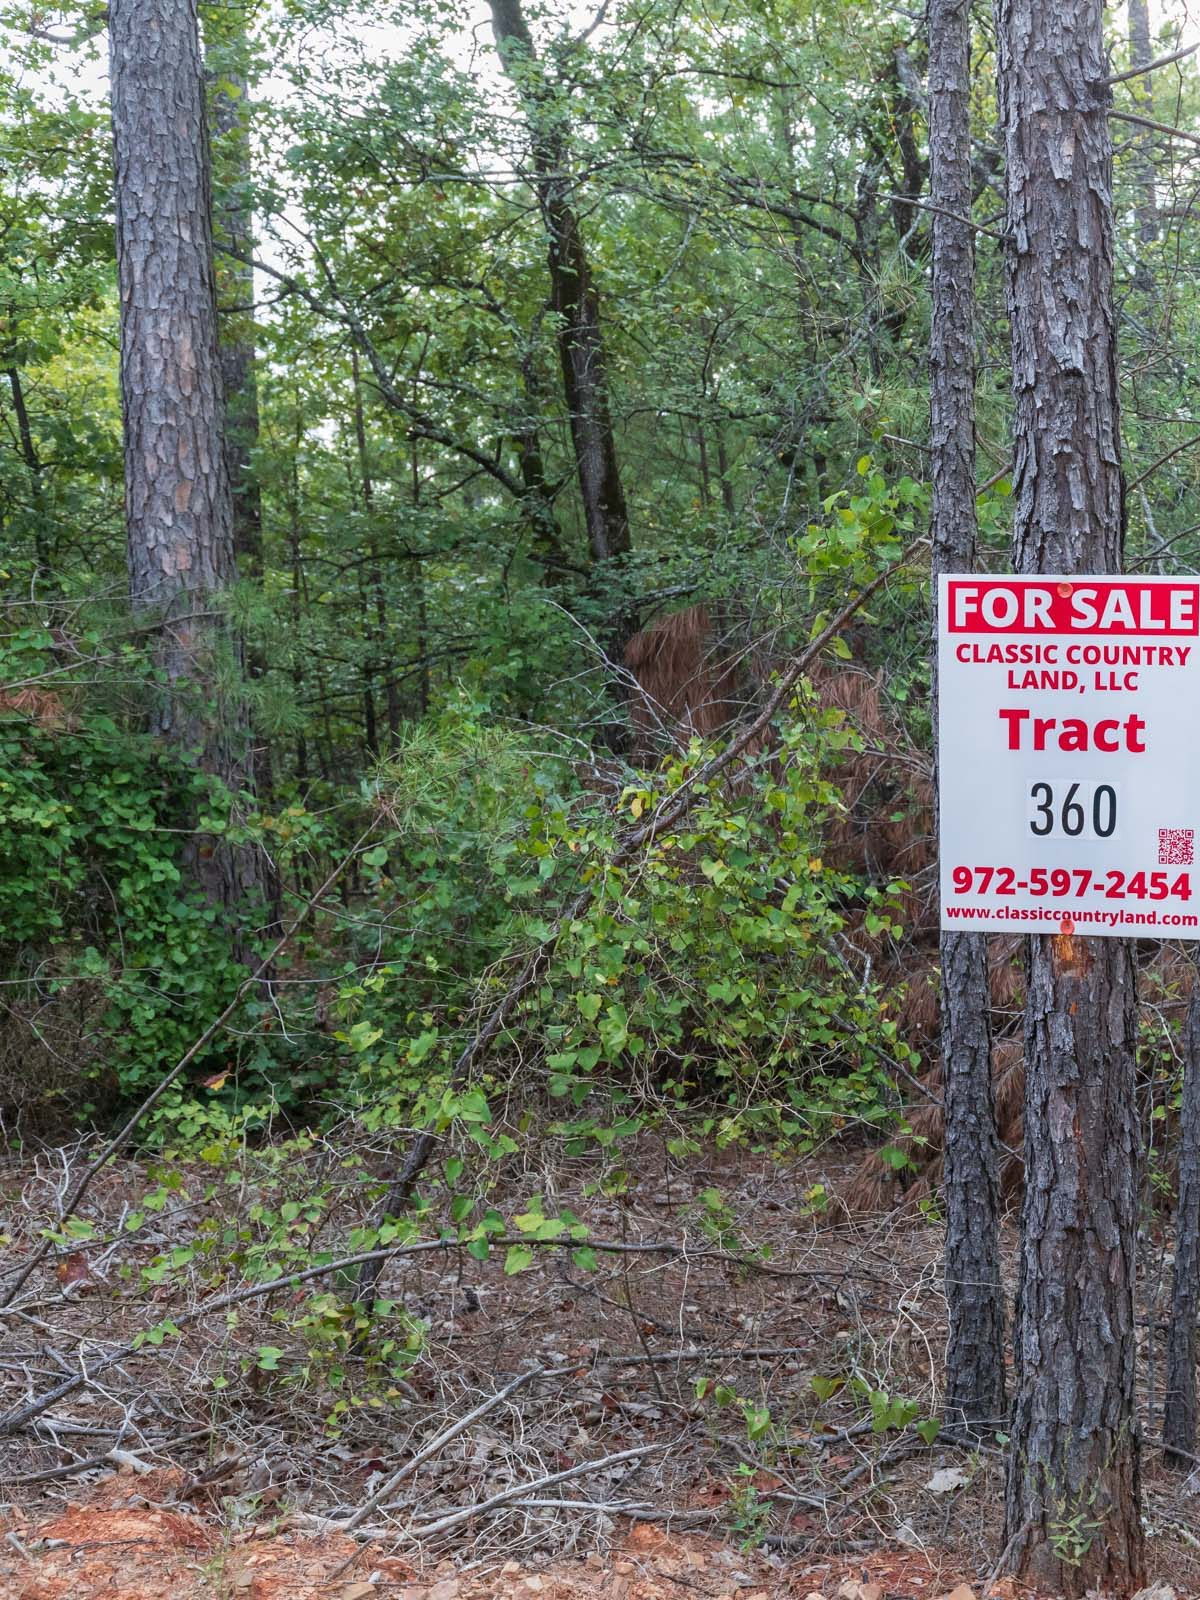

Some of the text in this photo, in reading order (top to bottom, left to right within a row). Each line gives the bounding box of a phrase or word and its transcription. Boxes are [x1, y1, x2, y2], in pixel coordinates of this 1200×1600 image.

[954, 587, 1194, 630] FOR SALE
[956, 643, 1191, 667] CLASSIC COUNTRY
[1007, 670, 1139, 694] LAND, LLC
[999, 709, 1146, 753] Tract
[1029, 782, 1117, 838] 360
[952, 866, 1192, 901] 972-597-2454
[946, 905, 1198, 927] www.classiccountryland.com
